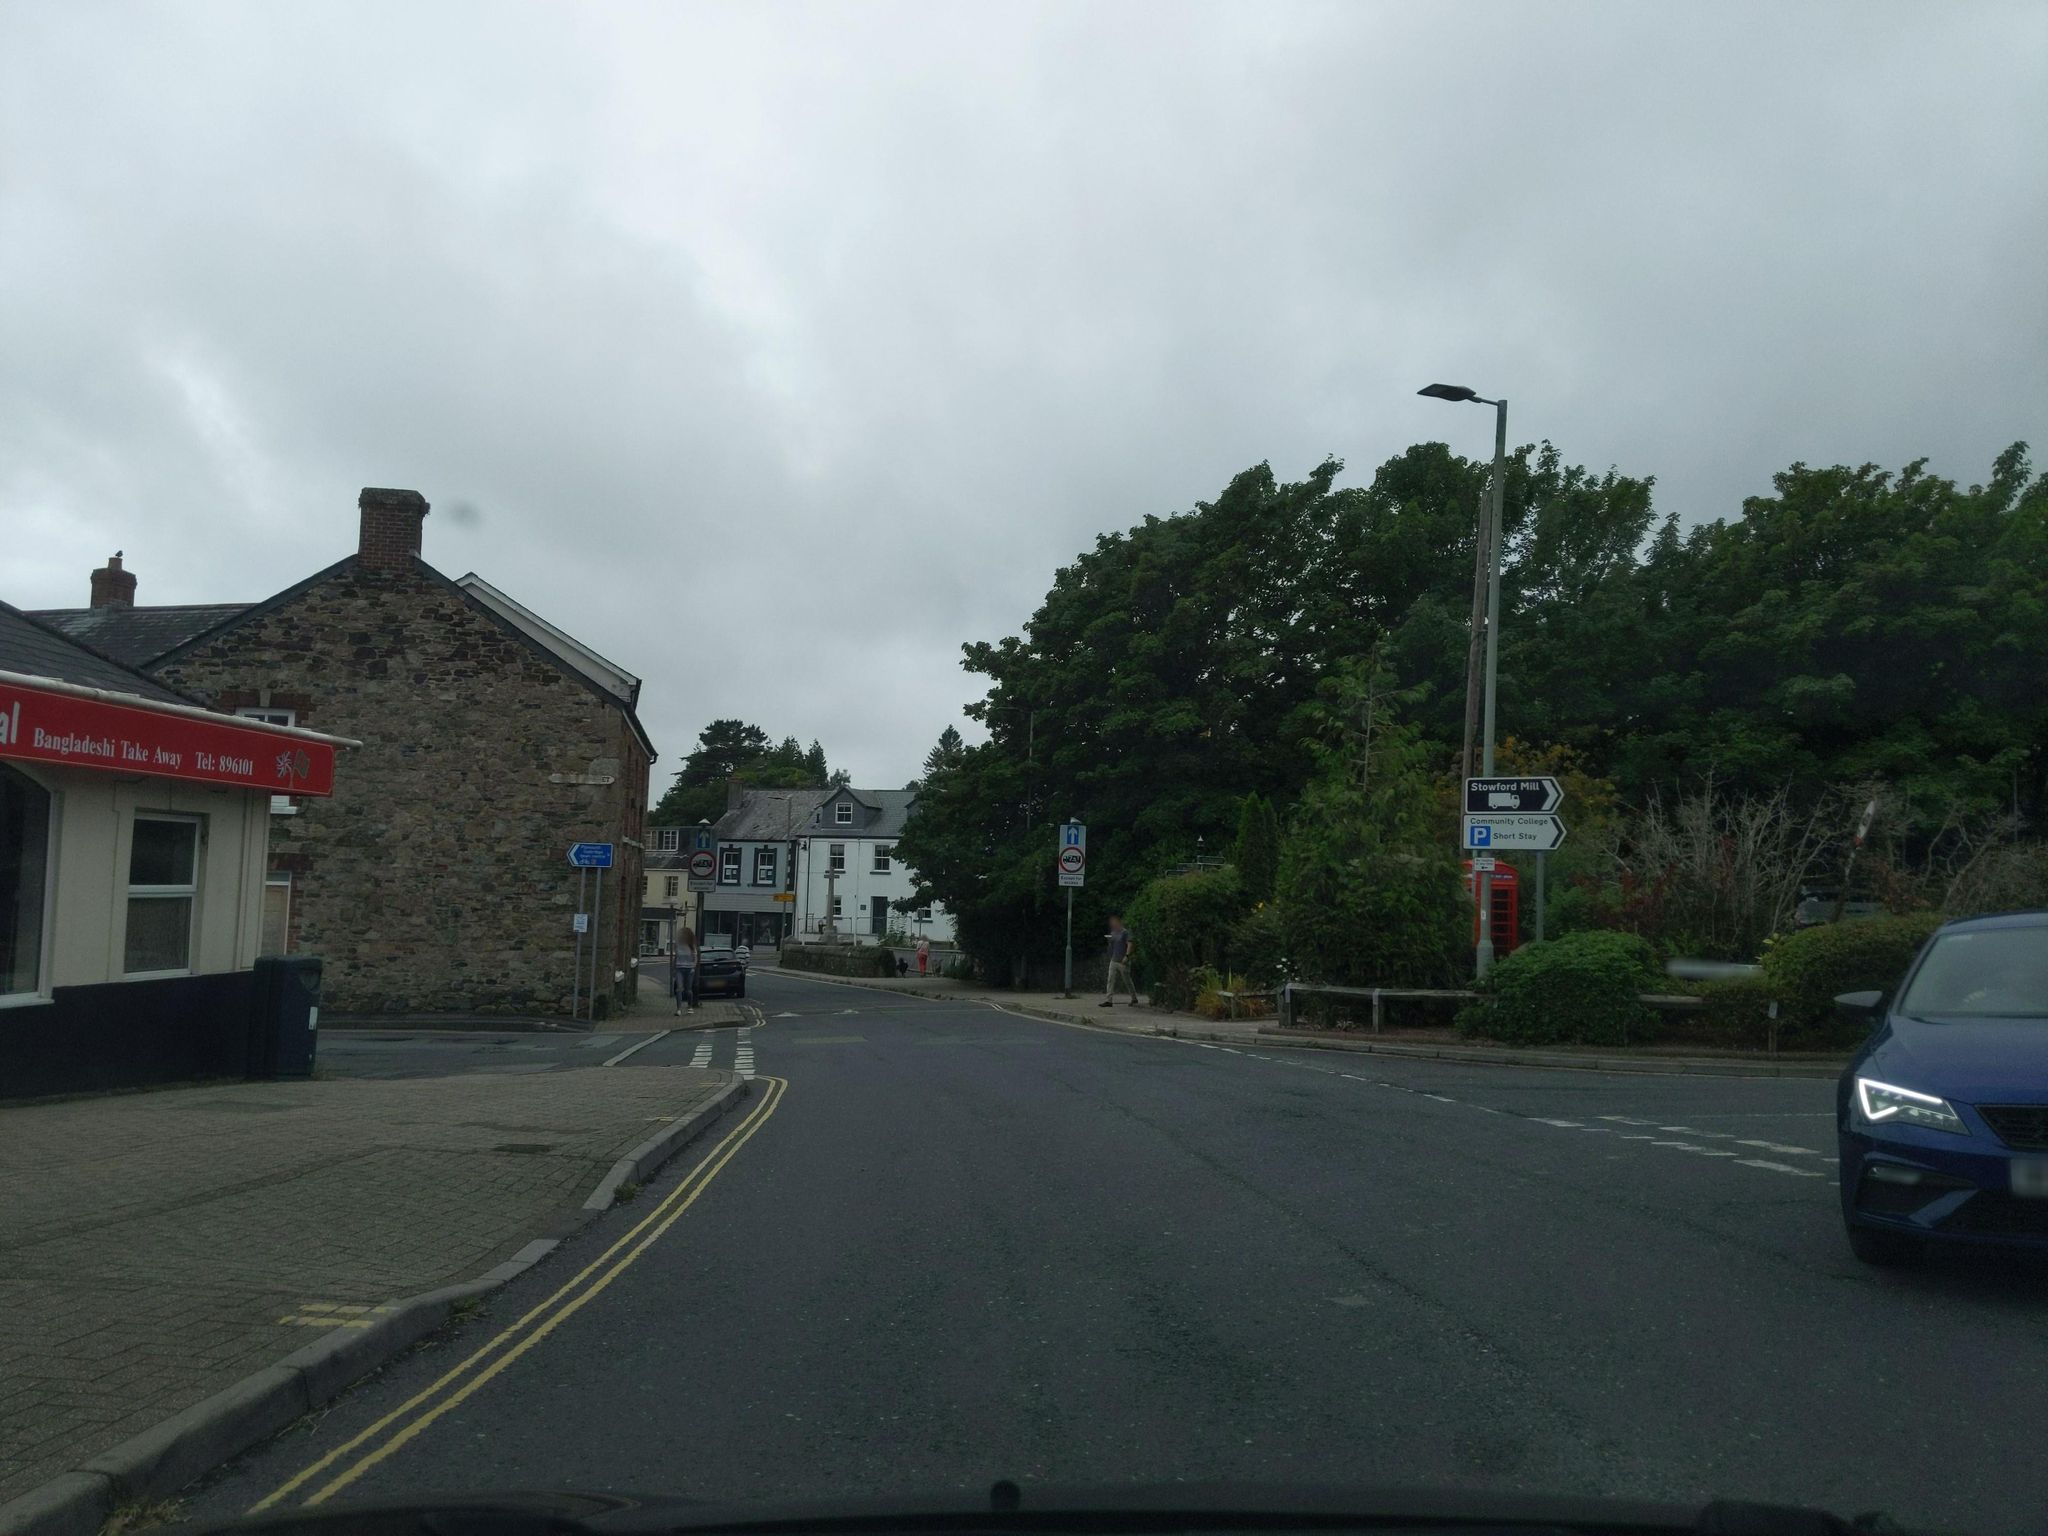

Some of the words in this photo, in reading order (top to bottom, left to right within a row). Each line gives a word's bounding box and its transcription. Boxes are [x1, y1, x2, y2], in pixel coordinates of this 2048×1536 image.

[33, 727, 115, 757] Bangladeshi
[120, 740, 149, 762] Take
[153, 746, 182, 769] Away
[195, 752, 215, 770] Tel:
[219, 755, 253, 776] 896101
[1471, 782, 1517, 791] Stowford
[1521, 782, 1540, 790] Mill
[1470, 817, 1514, 826] Community
[1518, 817, 1548, 825] College
[1473, 827, 1487, 844] P
[1493, 832, 1515, 840] Short
[1519, 832, 1537, 841] Stay
